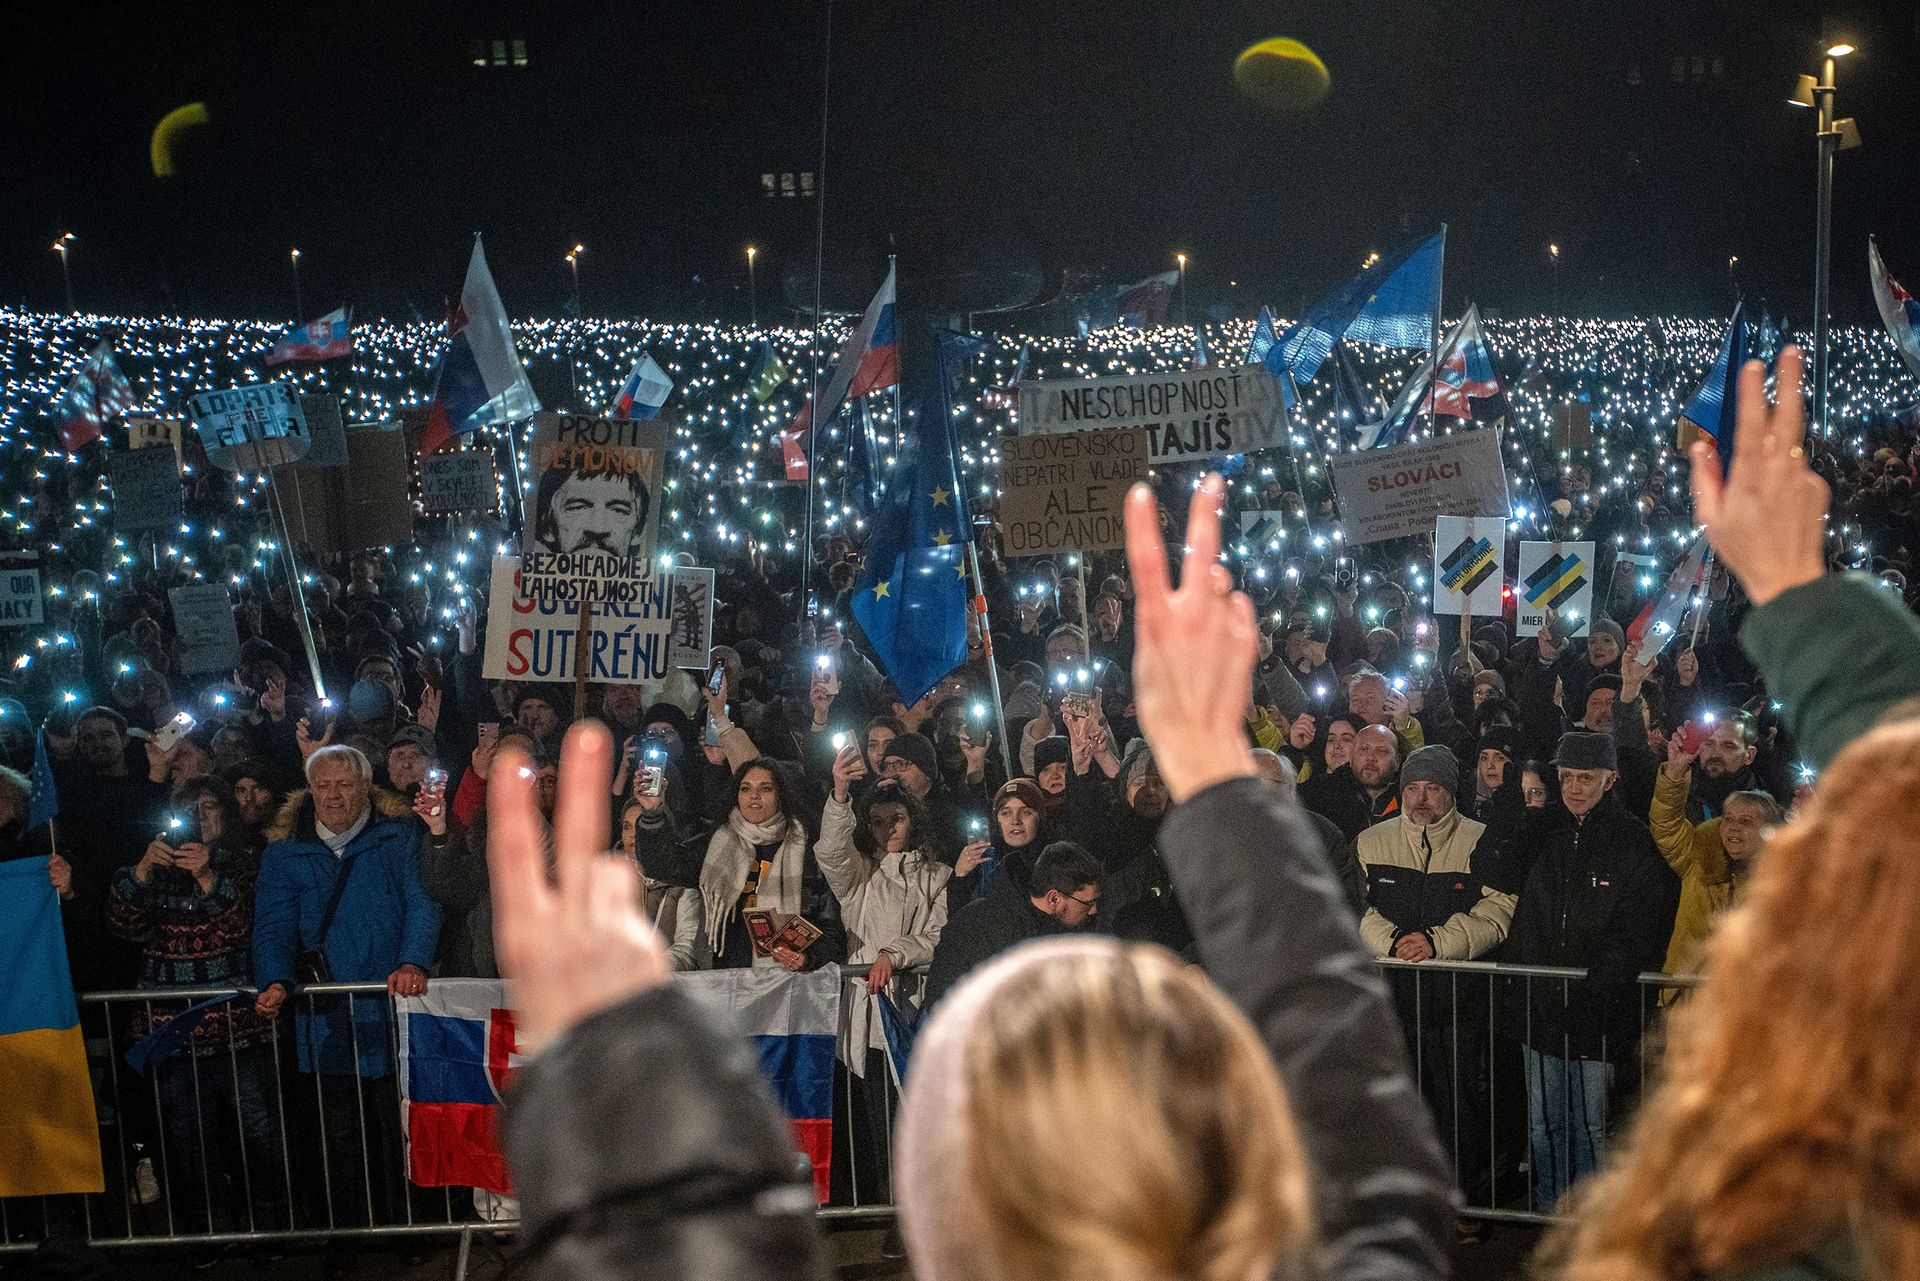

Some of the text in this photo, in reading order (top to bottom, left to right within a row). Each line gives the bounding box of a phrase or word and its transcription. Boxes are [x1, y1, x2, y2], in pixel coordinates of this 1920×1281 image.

[1061, 369, 1241, 421] NESCHOPNOSŤ
[558, 416, 638, 447] PROTI
[1000, 433, 1136, 463] SLOVENSKO
[1003, 459, 1076, 487] NEPATRÍ
[1367, 462, 1462, 493] SLOVÁCI
[1045, 485, 1108, 516] ALE
[522, 552, 650, 579] BEZOHĽADNEJ
[10, 575, 35, 594] OUR
[521, 576, 653, 603] ĽAHOSTAJNOSTI
[1448, 573, 1465, 590] MIER
[0, 599, 33, 619] ACY
[1522, 616, 1543, 626] MIER
